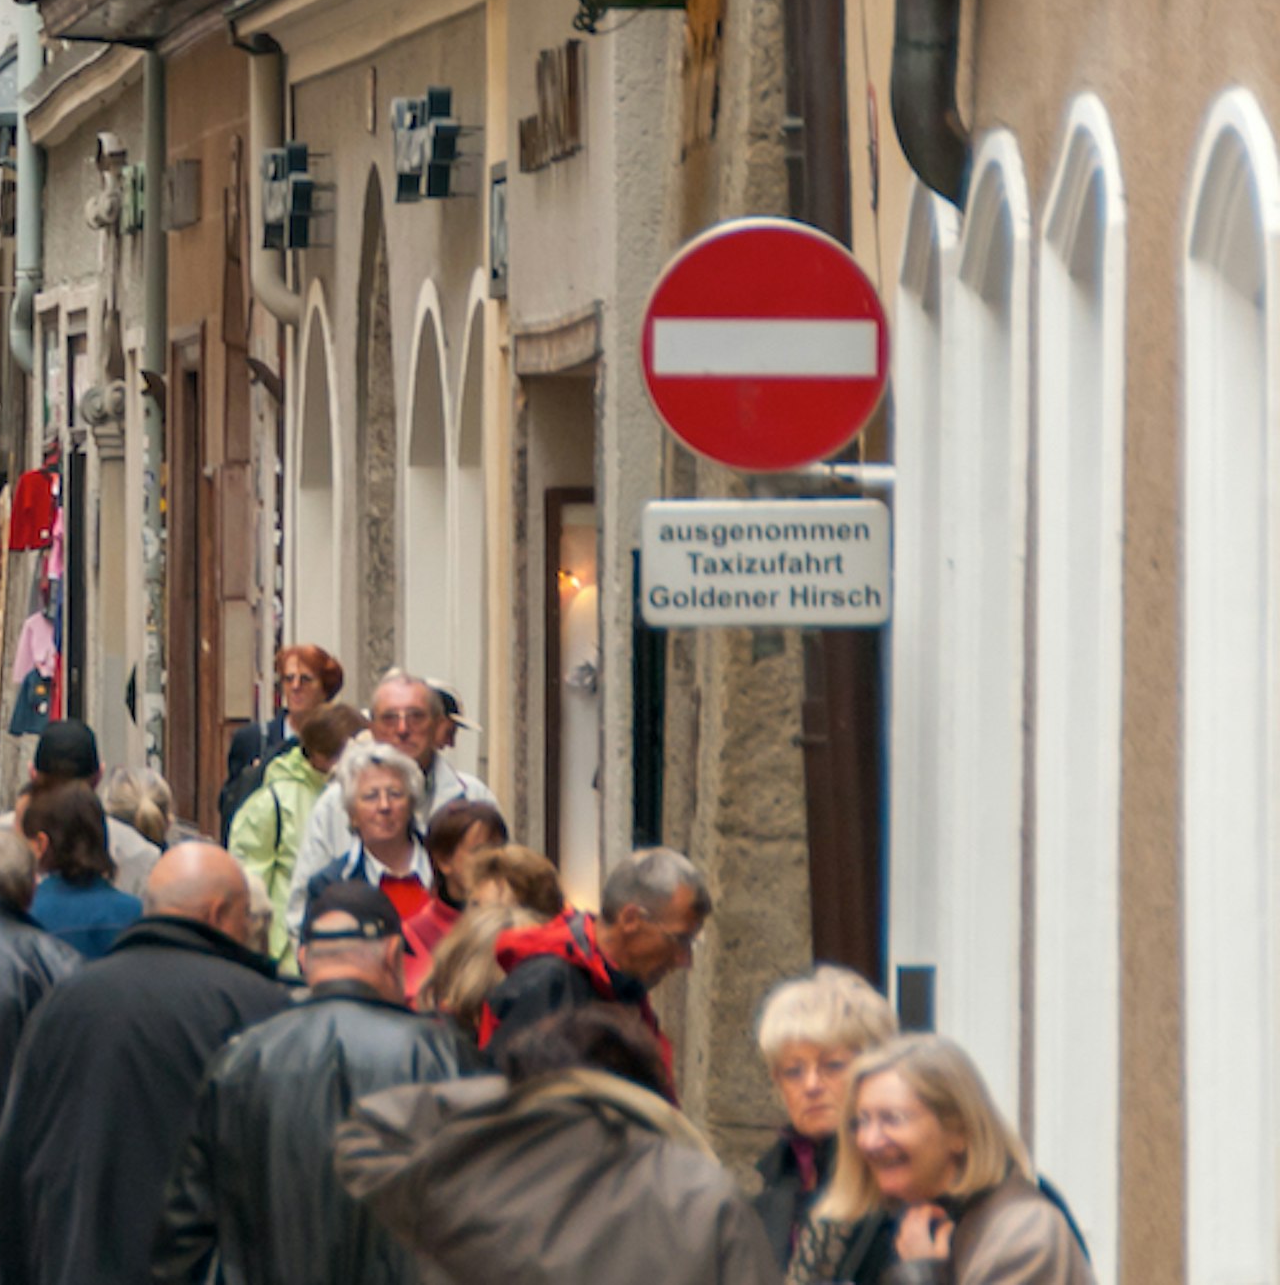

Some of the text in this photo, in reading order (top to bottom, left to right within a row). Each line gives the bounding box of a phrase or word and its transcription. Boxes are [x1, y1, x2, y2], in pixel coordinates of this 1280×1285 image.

[659, 522, 871, 548] ausgenommen
[688, 551, 845, 576] Taxizufahrt
[648, 583, 882, 609] Goldener Hirsch
